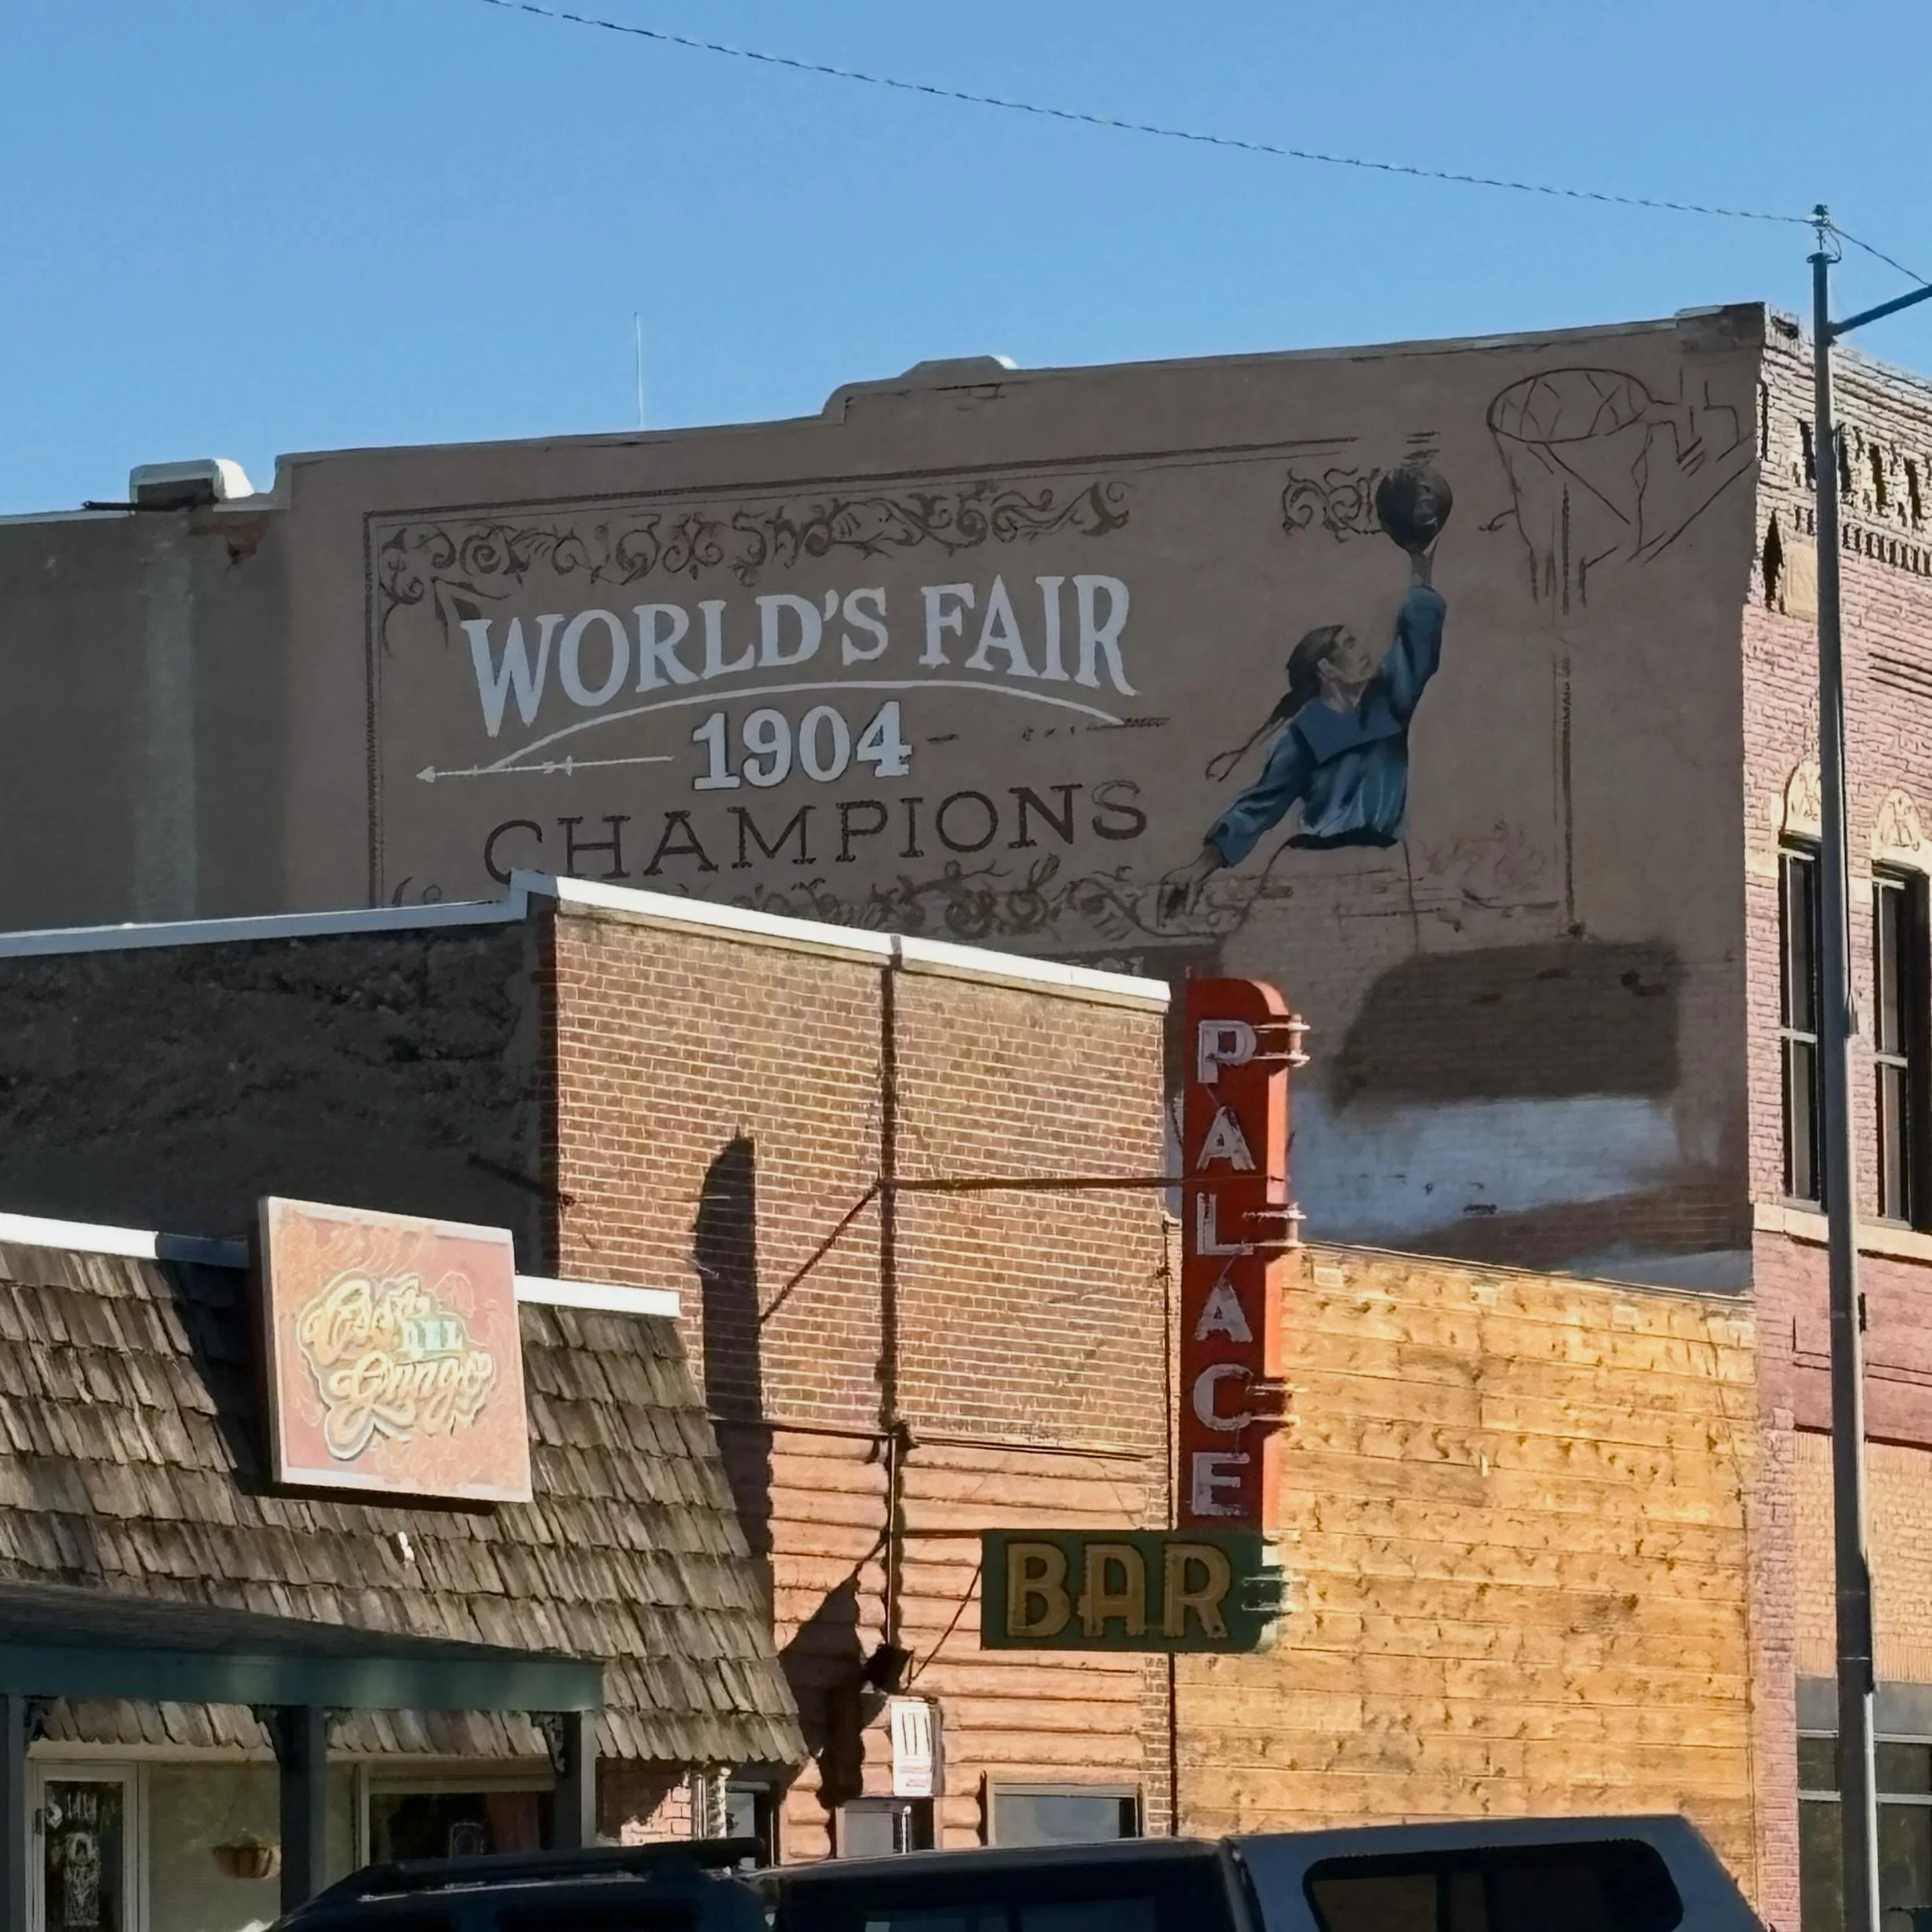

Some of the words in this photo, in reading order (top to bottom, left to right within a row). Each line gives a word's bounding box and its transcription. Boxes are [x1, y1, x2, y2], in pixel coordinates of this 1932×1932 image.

[459, 587, 889, 738] WORLD'S
[917, 573, 1141, 696] FAIR
[691, 701, 913, 791] 1904
[483, 779, 1148, 885] CHAMPIONS
[1191, 1019, 1258, 1516] PALACE
[1006, 1543, 1231, 1639] BAR
